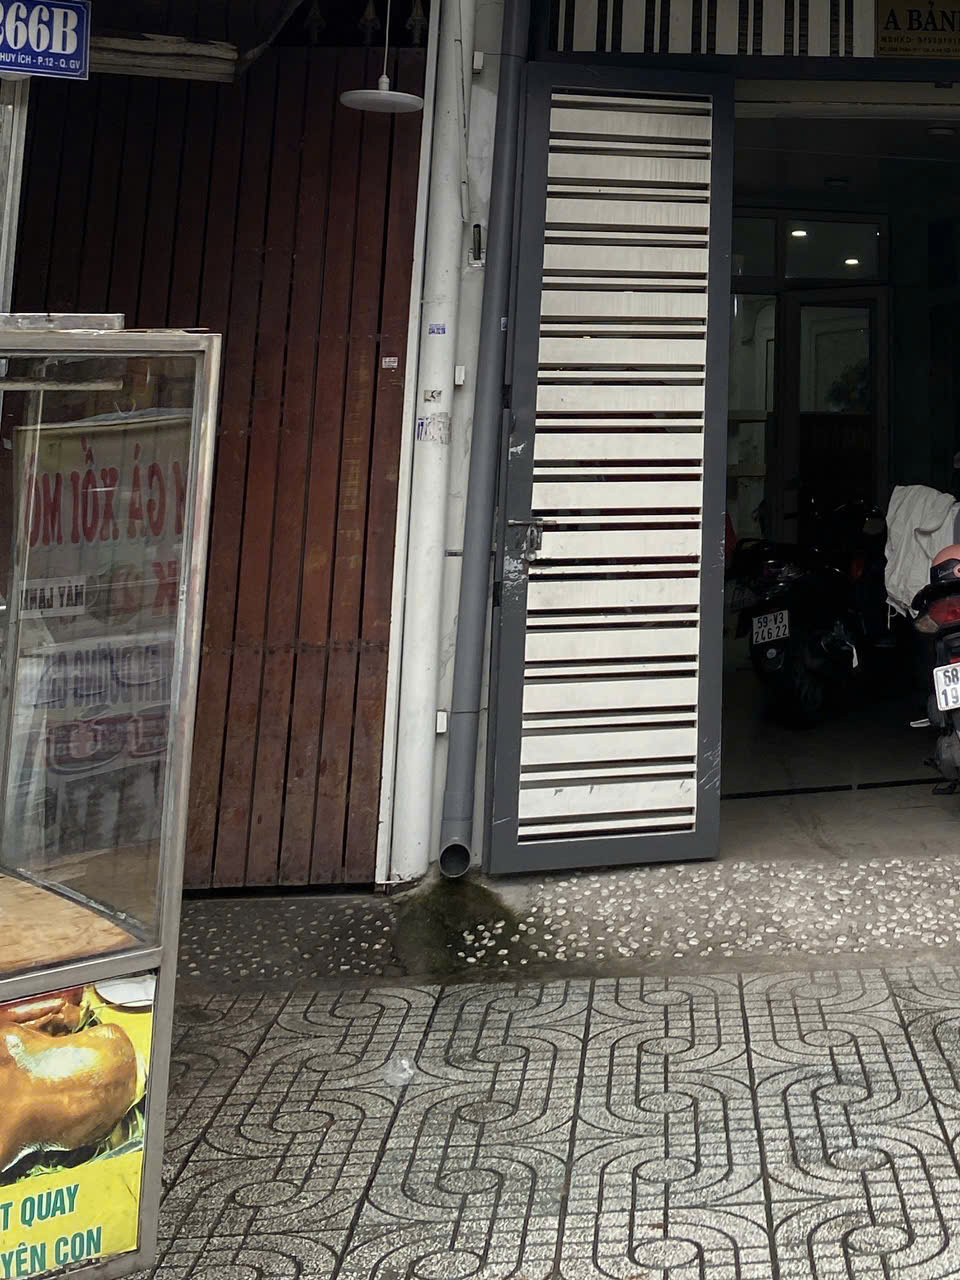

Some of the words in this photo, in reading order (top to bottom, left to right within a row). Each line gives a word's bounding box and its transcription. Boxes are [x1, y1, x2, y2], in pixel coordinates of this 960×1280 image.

[0, 0, 78, 55] 66B
[884, 8, 900, 31] A
[0, 52, 16, 62] HUY
[37, 56, 53, 66] P.12
[20, 1184, 79, 1226] QUAY
[55, 1226, 102, 1265] CON
